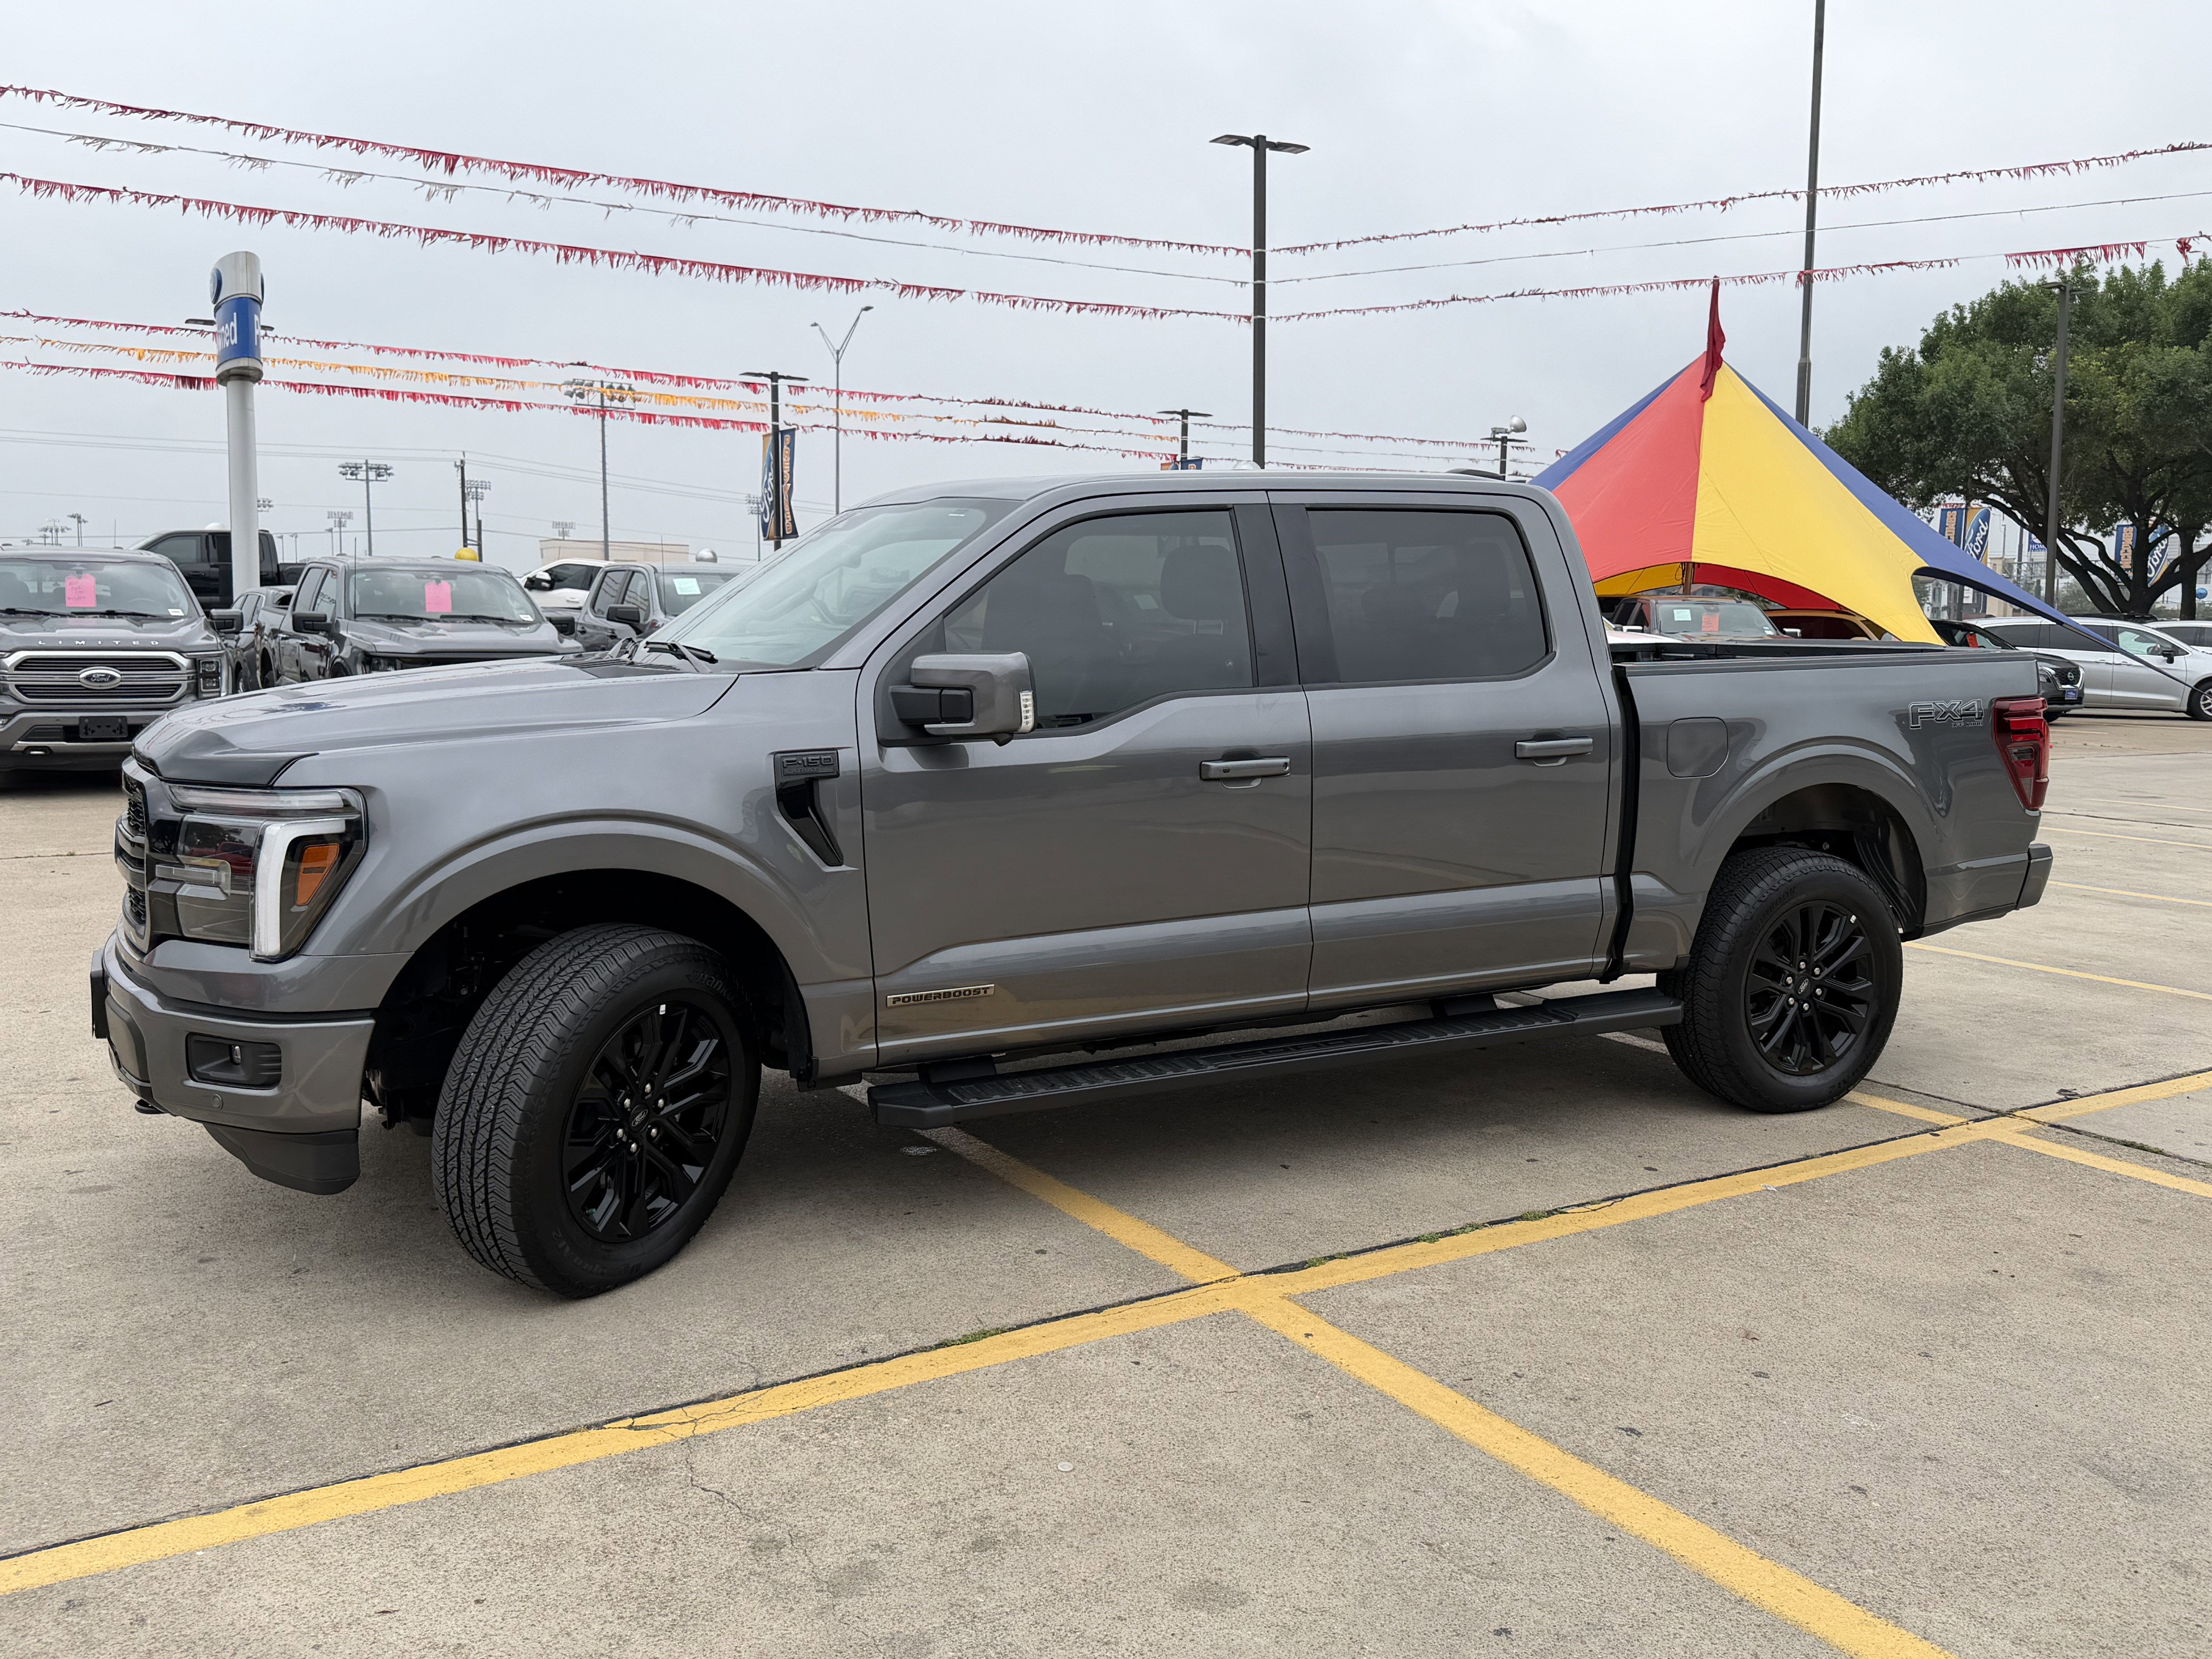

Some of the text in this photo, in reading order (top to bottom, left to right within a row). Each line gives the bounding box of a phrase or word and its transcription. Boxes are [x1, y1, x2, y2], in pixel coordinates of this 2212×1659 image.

[90, 673, 111, 682] Ford
[1908, 699, 1984, 729] FX4
[892, 987, 990, 1005] POWERBOOST
